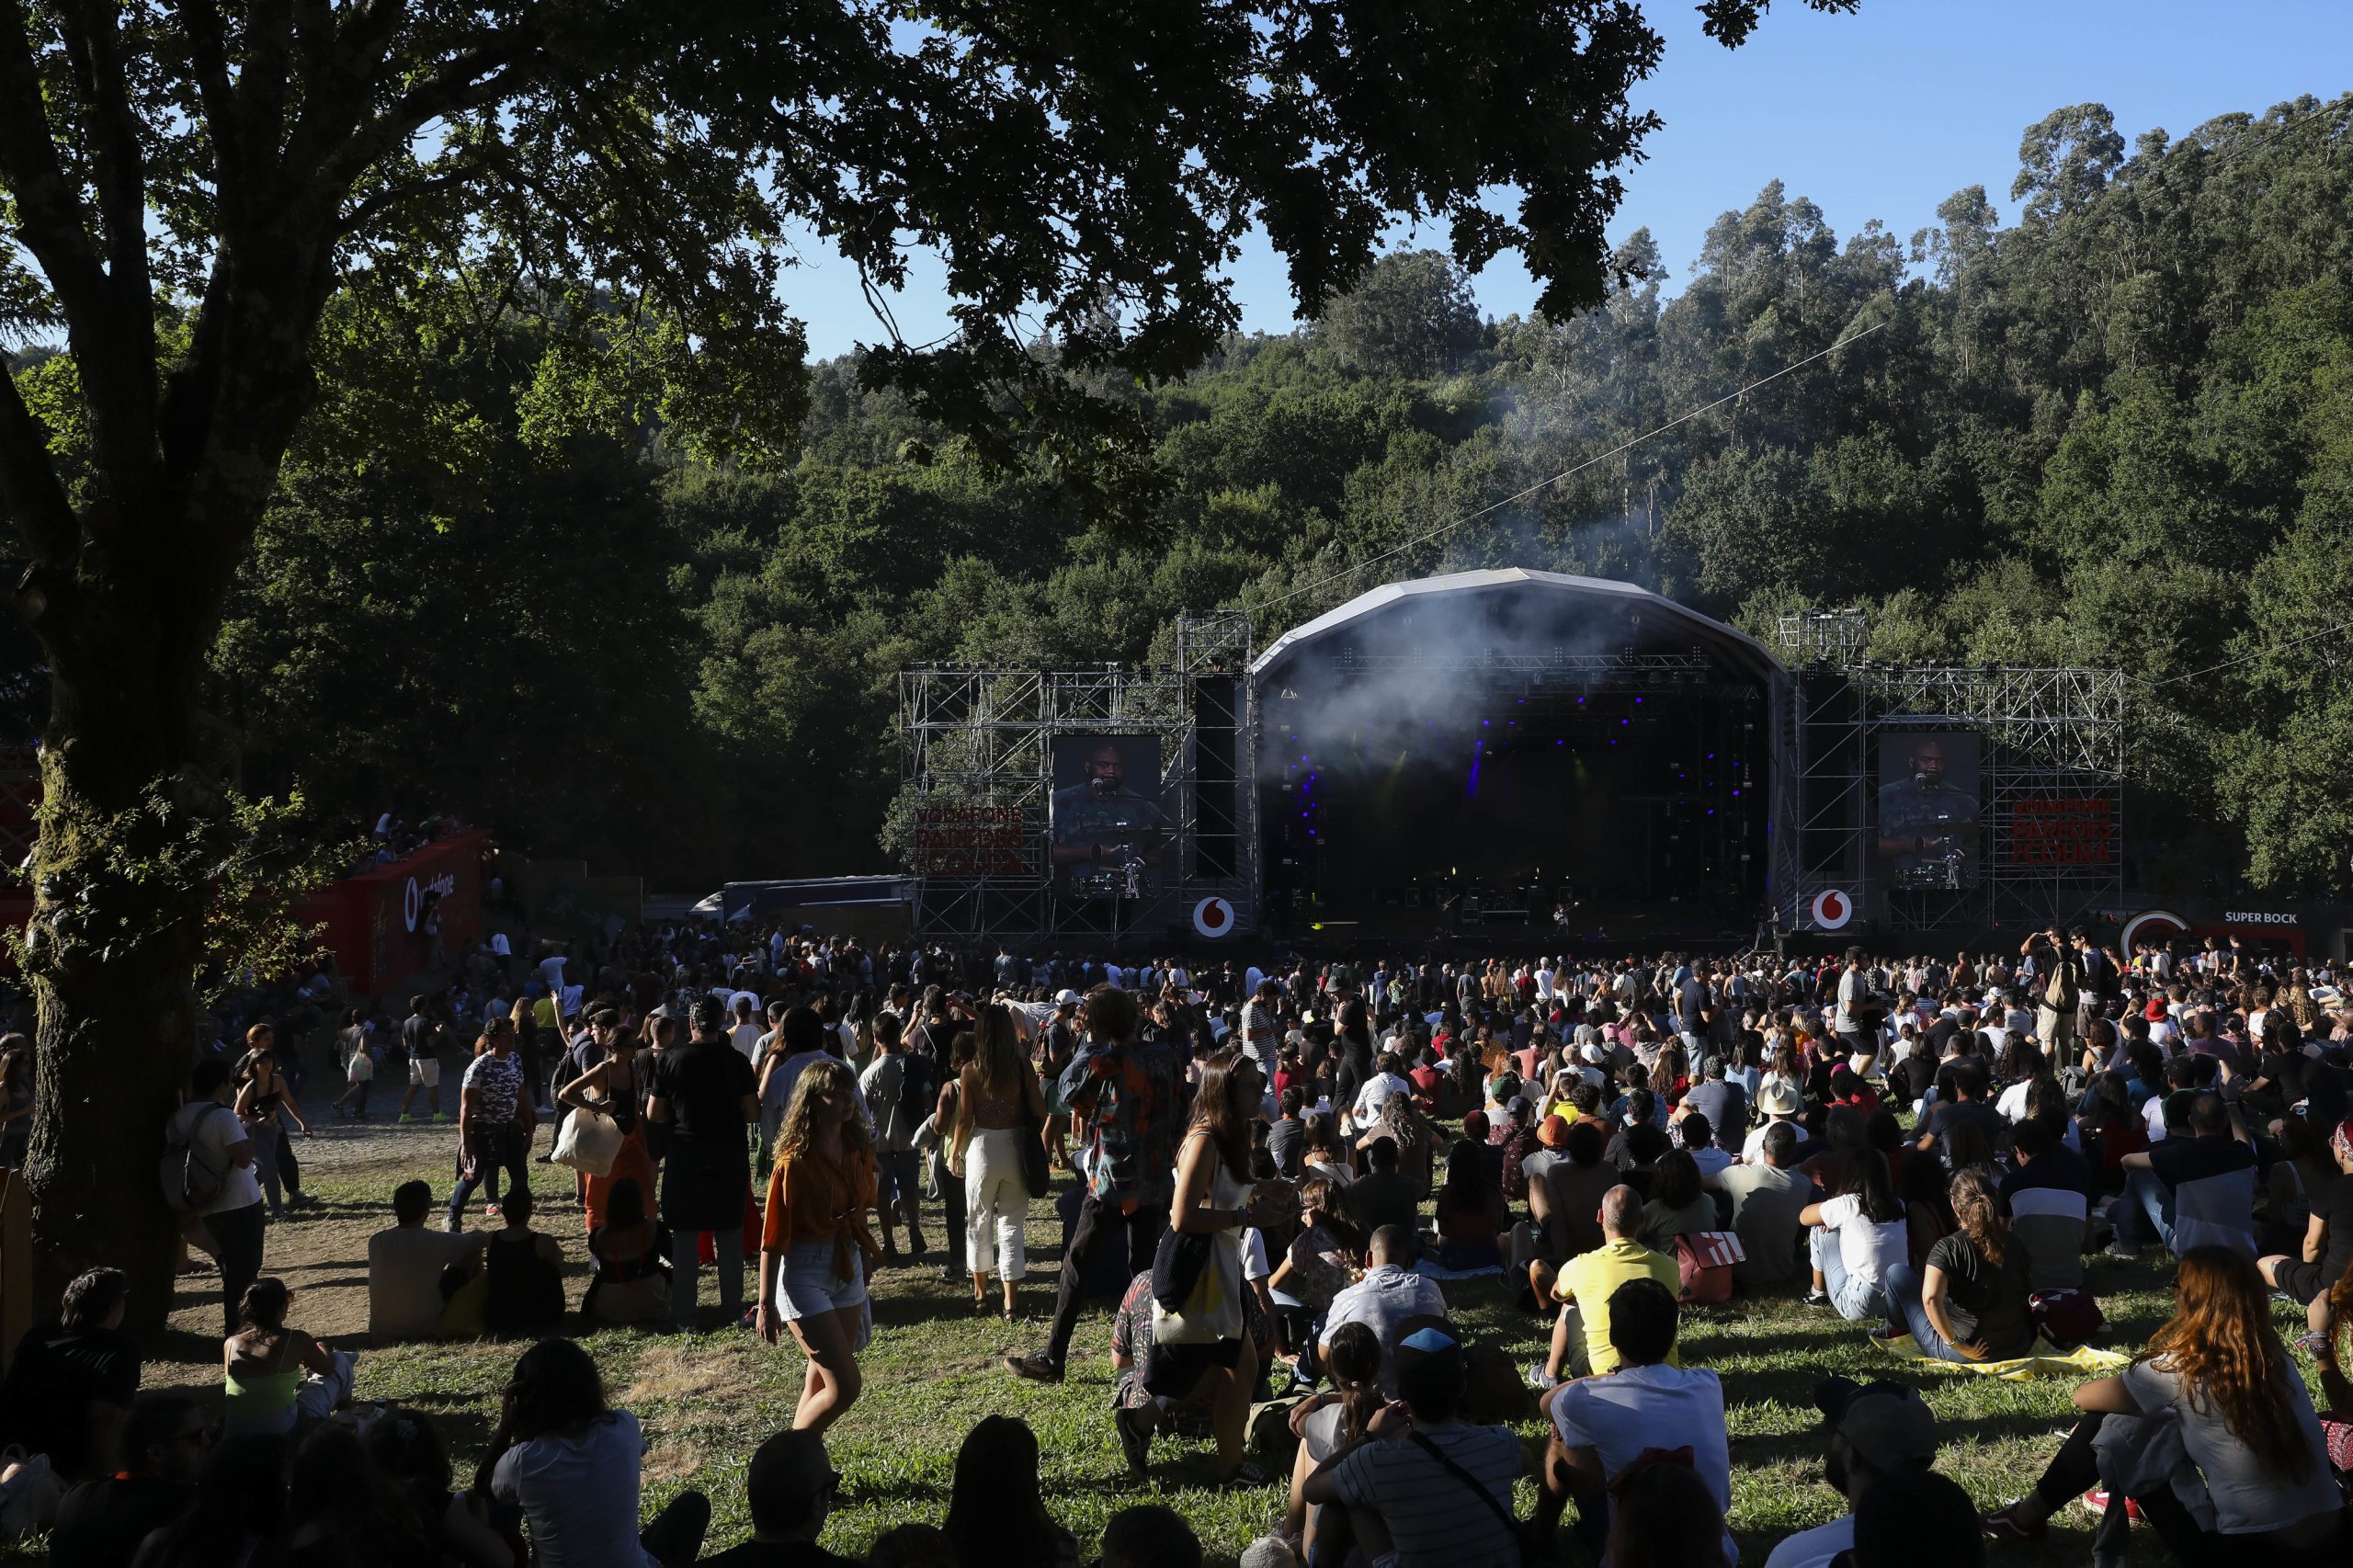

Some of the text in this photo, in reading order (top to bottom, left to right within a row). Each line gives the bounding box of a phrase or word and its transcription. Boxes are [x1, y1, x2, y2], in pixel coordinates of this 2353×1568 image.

[2015, 799, 2109, 813] VODAFONE
[916, 808, 1021, 824] VODAFONE
[2014, 819, 2113, 838] PAREDES
[2025, 842, 2114, 864] COURA
[926, 853, 1025, 875] COURA
[2225, 912, 2298, 925] SUPER BOCK
